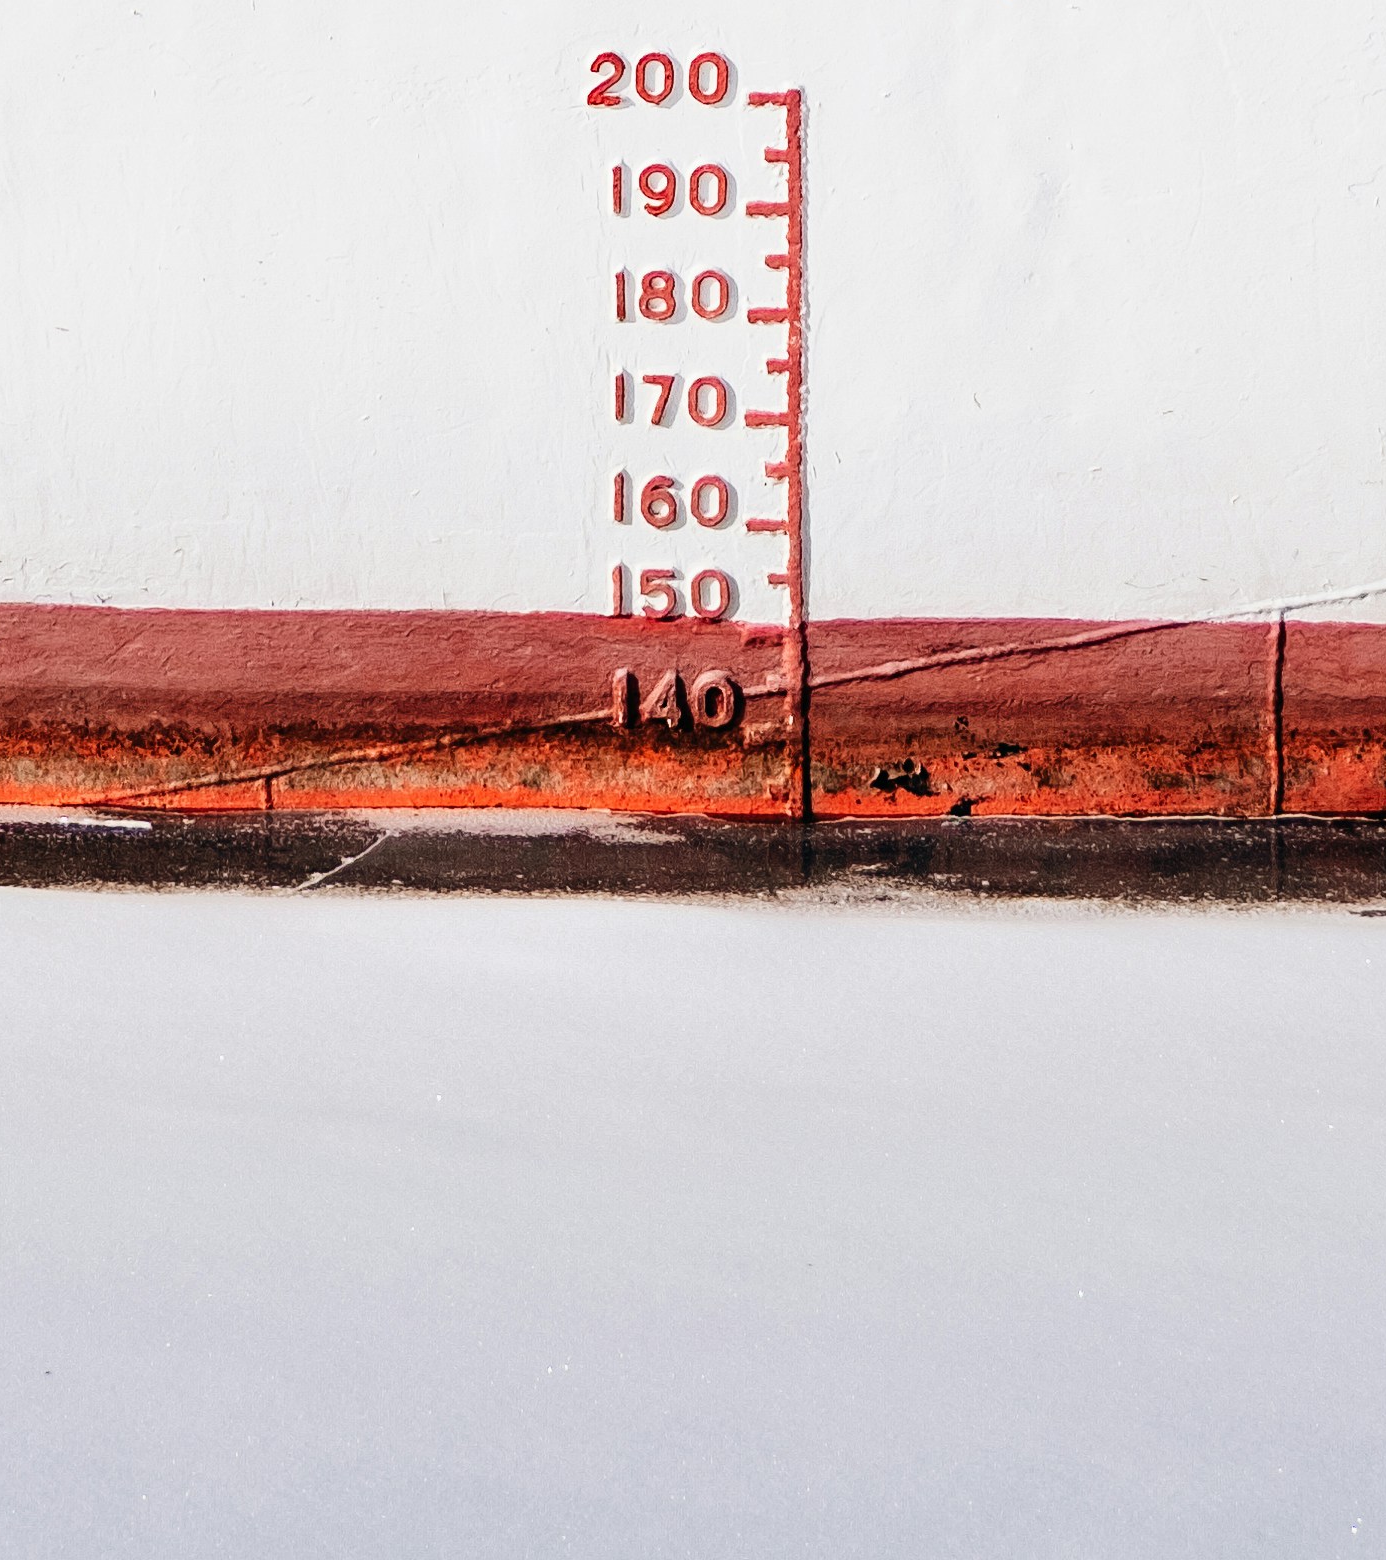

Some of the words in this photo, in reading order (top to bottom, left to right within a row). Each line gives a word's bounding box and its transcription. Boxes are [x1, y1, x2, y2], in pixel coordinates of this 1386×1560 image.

[586, 51, 730, 107] 200
[612, 163, 729, 218] 190
[615, 270, 730, 322] 180
[615, 375, 729, 427] 170
[613, 474, 729, 528] 160
[612, 565, 730, 619] 150
[612, 668, 735, 729] 140
